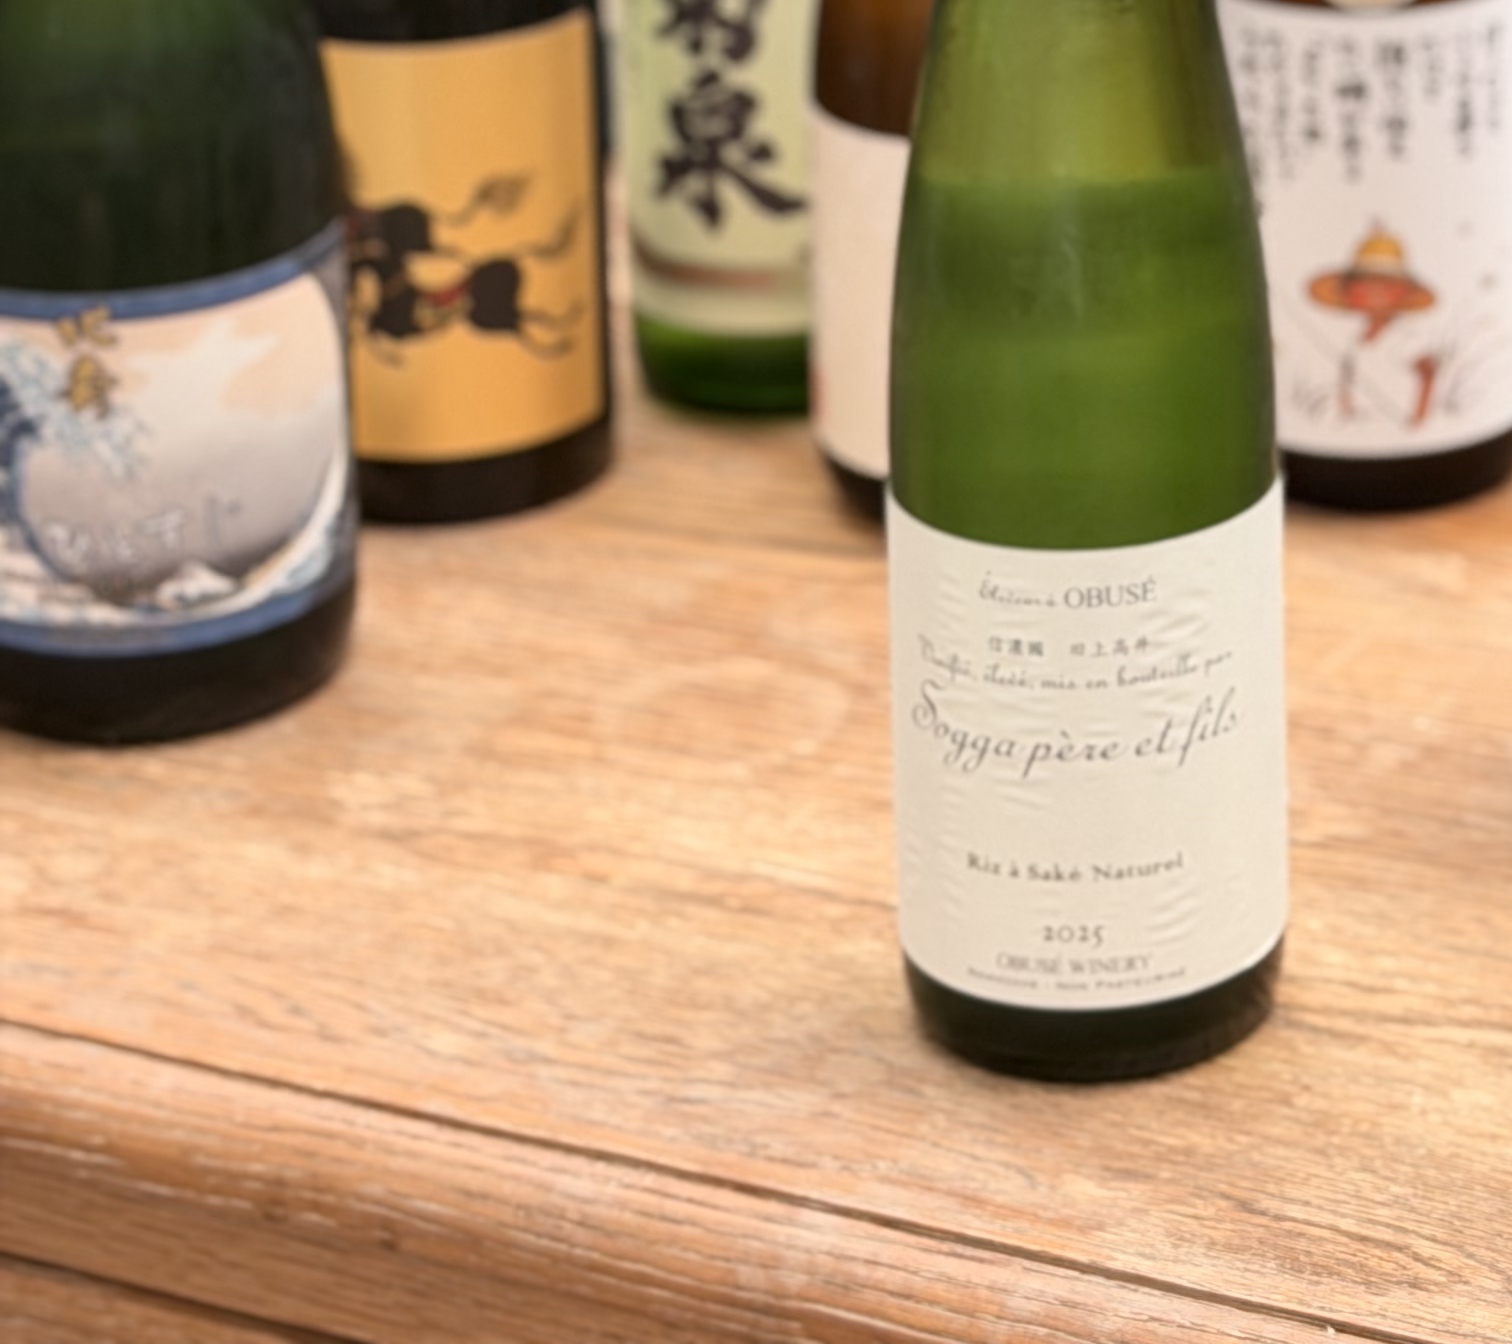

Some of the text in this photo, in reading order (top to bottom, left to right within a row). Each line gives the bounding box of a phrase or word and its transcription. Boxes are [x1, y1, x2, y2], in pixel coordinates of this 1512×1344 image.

[1063, 575, 1157, 609] OBUSÉ
[1084, 678, 1109, 690] en
[911, 677, 1238, 780] Sogga père et fils
[1091, 850, 1184, 882] Naturel
[1042, 924, 1105, 949] 2025
